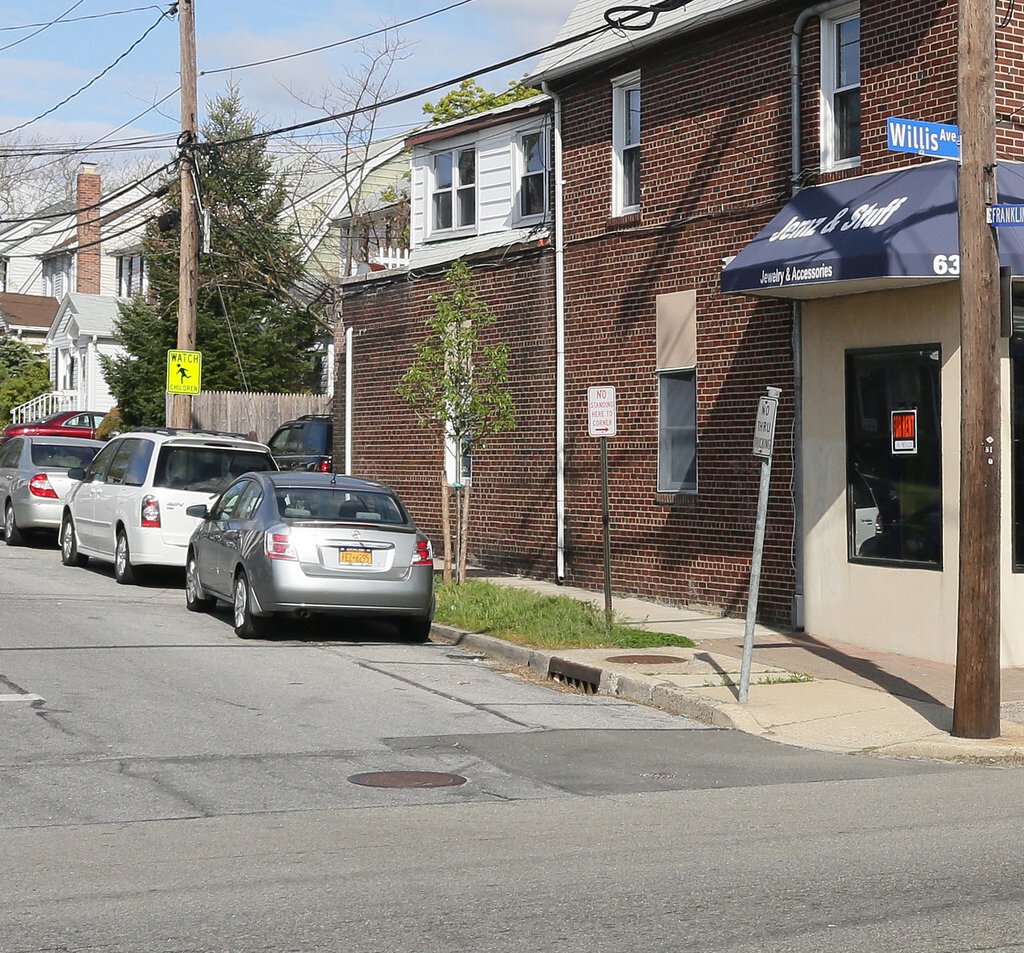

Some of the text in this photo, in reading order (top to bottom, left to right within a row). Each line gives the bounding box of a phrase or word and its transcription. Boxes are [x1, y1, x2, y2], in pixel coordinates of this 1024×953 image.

[889, 122, 939, 152] Willis
[769, 196, 909, 242] Jemz & Stuff
[759, 263, 833, 286] Jewelry & Accessories
[932, 254, 960, 276] 63
[170, 353, 199, 364] WATCH
[170, 384, 198, 392] CHILDREN
[596, 390, 607, 399] NO
